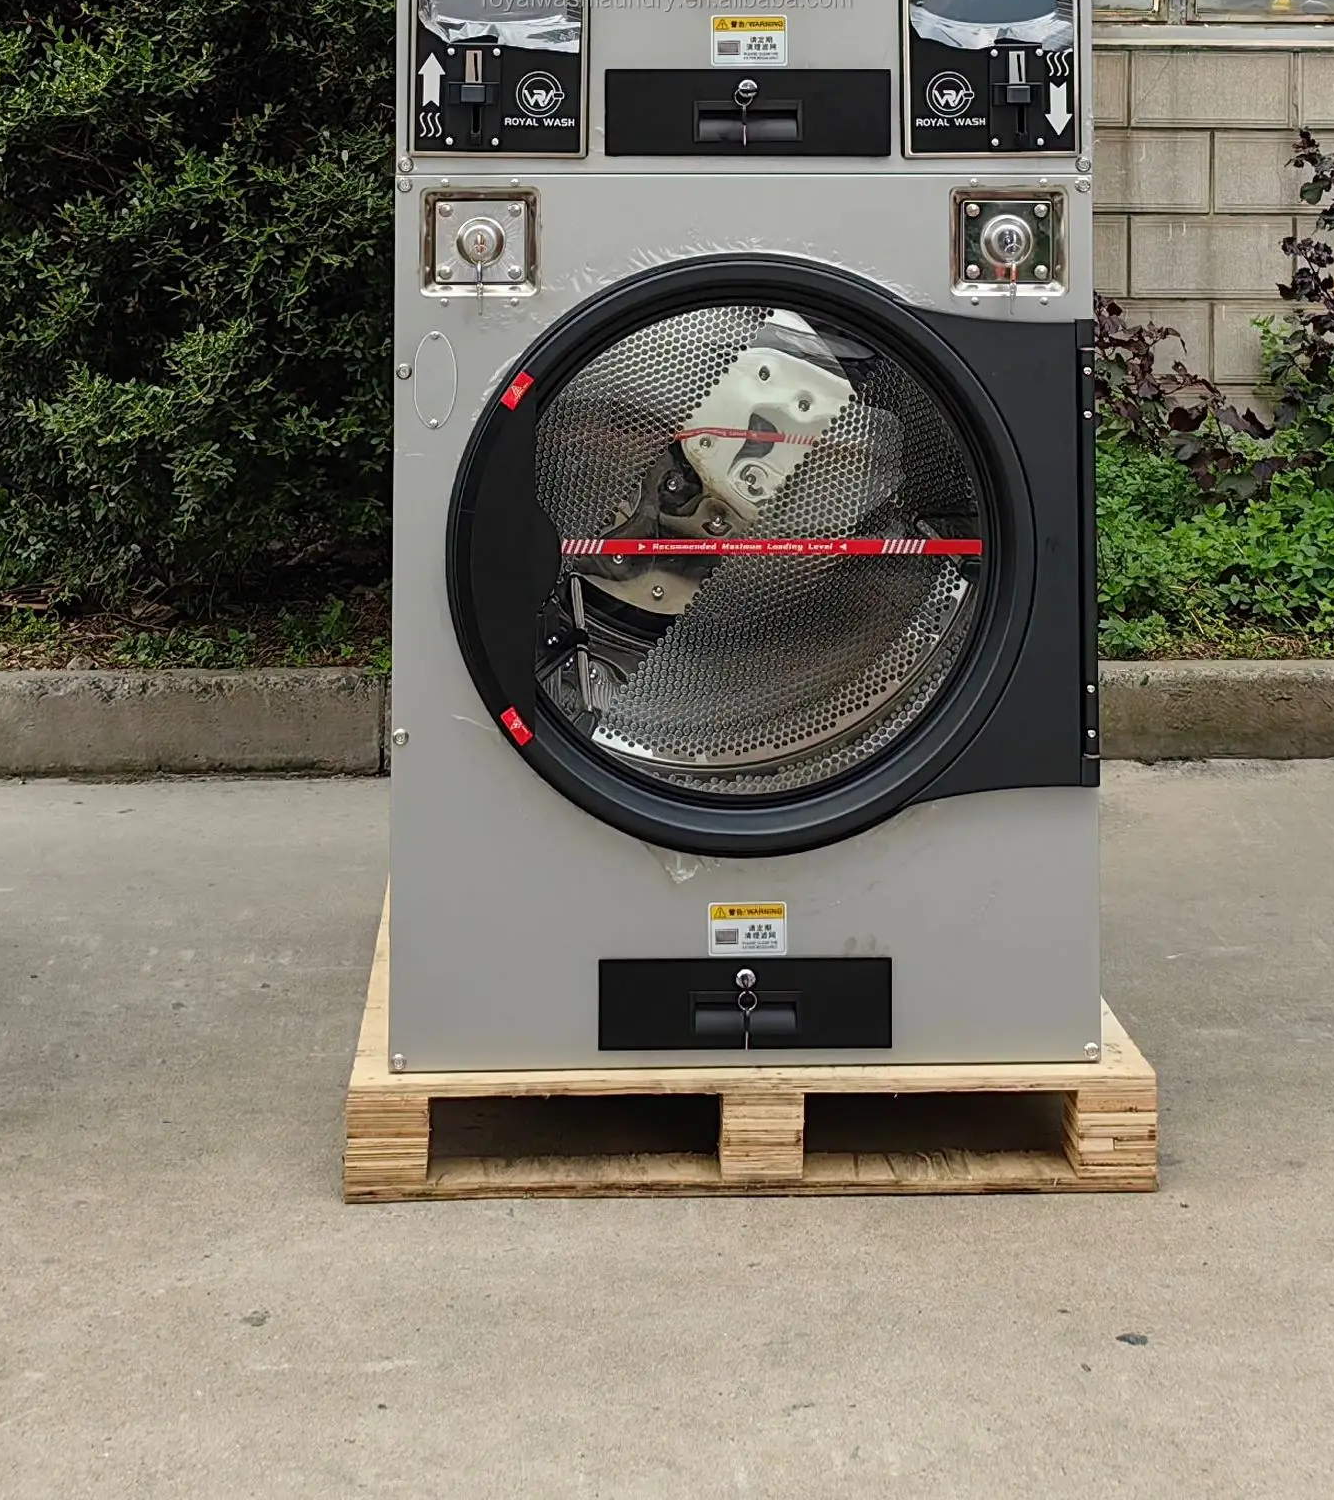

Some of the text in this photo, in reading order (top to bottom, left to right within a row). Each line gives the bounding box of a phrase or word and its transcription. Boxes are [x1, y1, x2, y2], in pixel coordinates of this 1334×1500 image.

[504, 117, 575, 127] ROYAL WASH
[915, 117, 986, 127] ROYAL WASH
[767, 543, 804, 552] Loading
